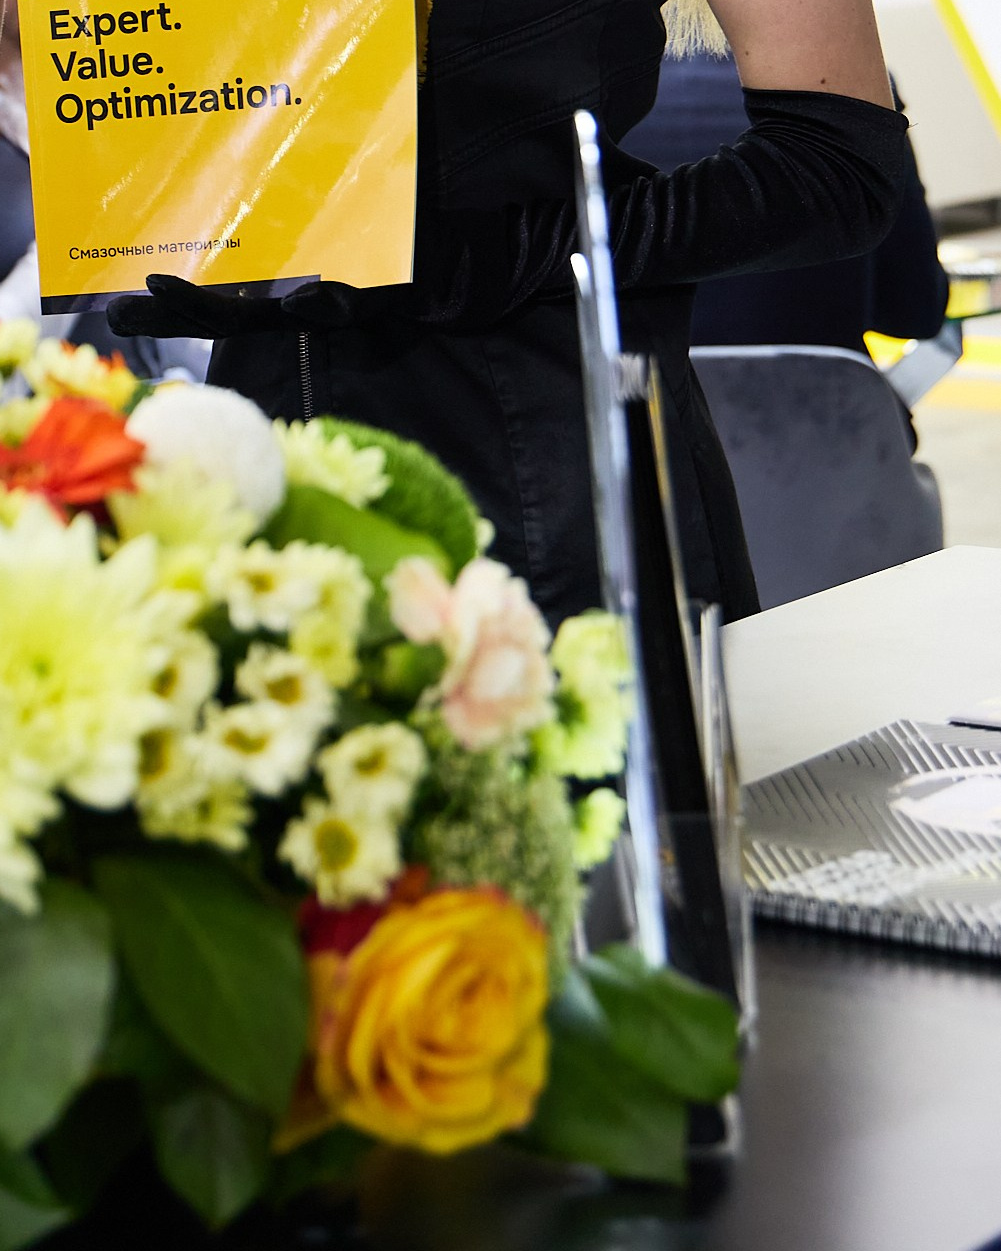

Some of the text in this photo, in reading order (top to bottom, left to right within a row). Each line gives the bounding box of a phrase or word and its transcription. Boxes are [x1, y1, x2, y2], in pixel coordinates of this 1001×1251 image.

[50, 3, 181, 45] Expert.
[51, 49, 164, 81] Value.
[55, 78, 302, 130] Optimization.
[69, 243, 154, 260] Смазочные
